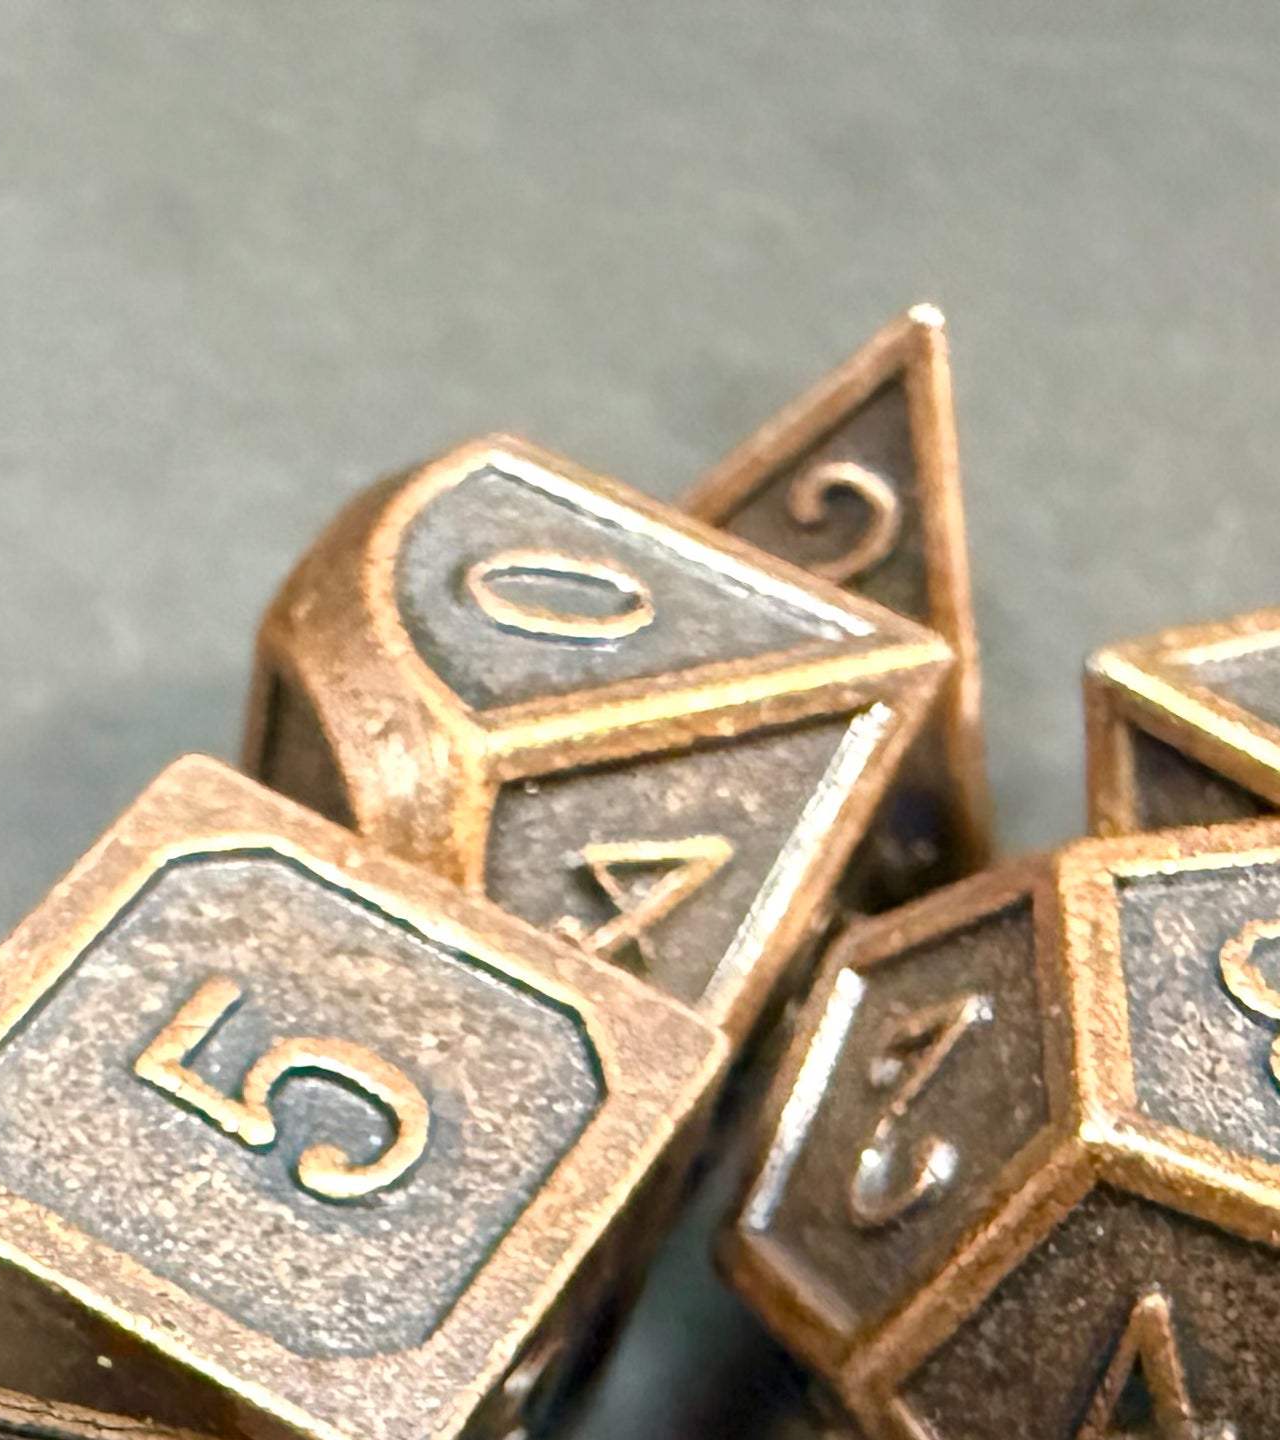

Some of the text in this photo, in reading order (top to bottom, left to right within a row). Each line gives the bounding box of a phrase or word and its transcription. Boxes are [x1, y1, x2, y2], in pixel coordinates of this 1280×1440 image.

[470, 549, 655, 640] 0
[554, 834, 734, 958] 4
[133, 976, 430, 1199] 5
